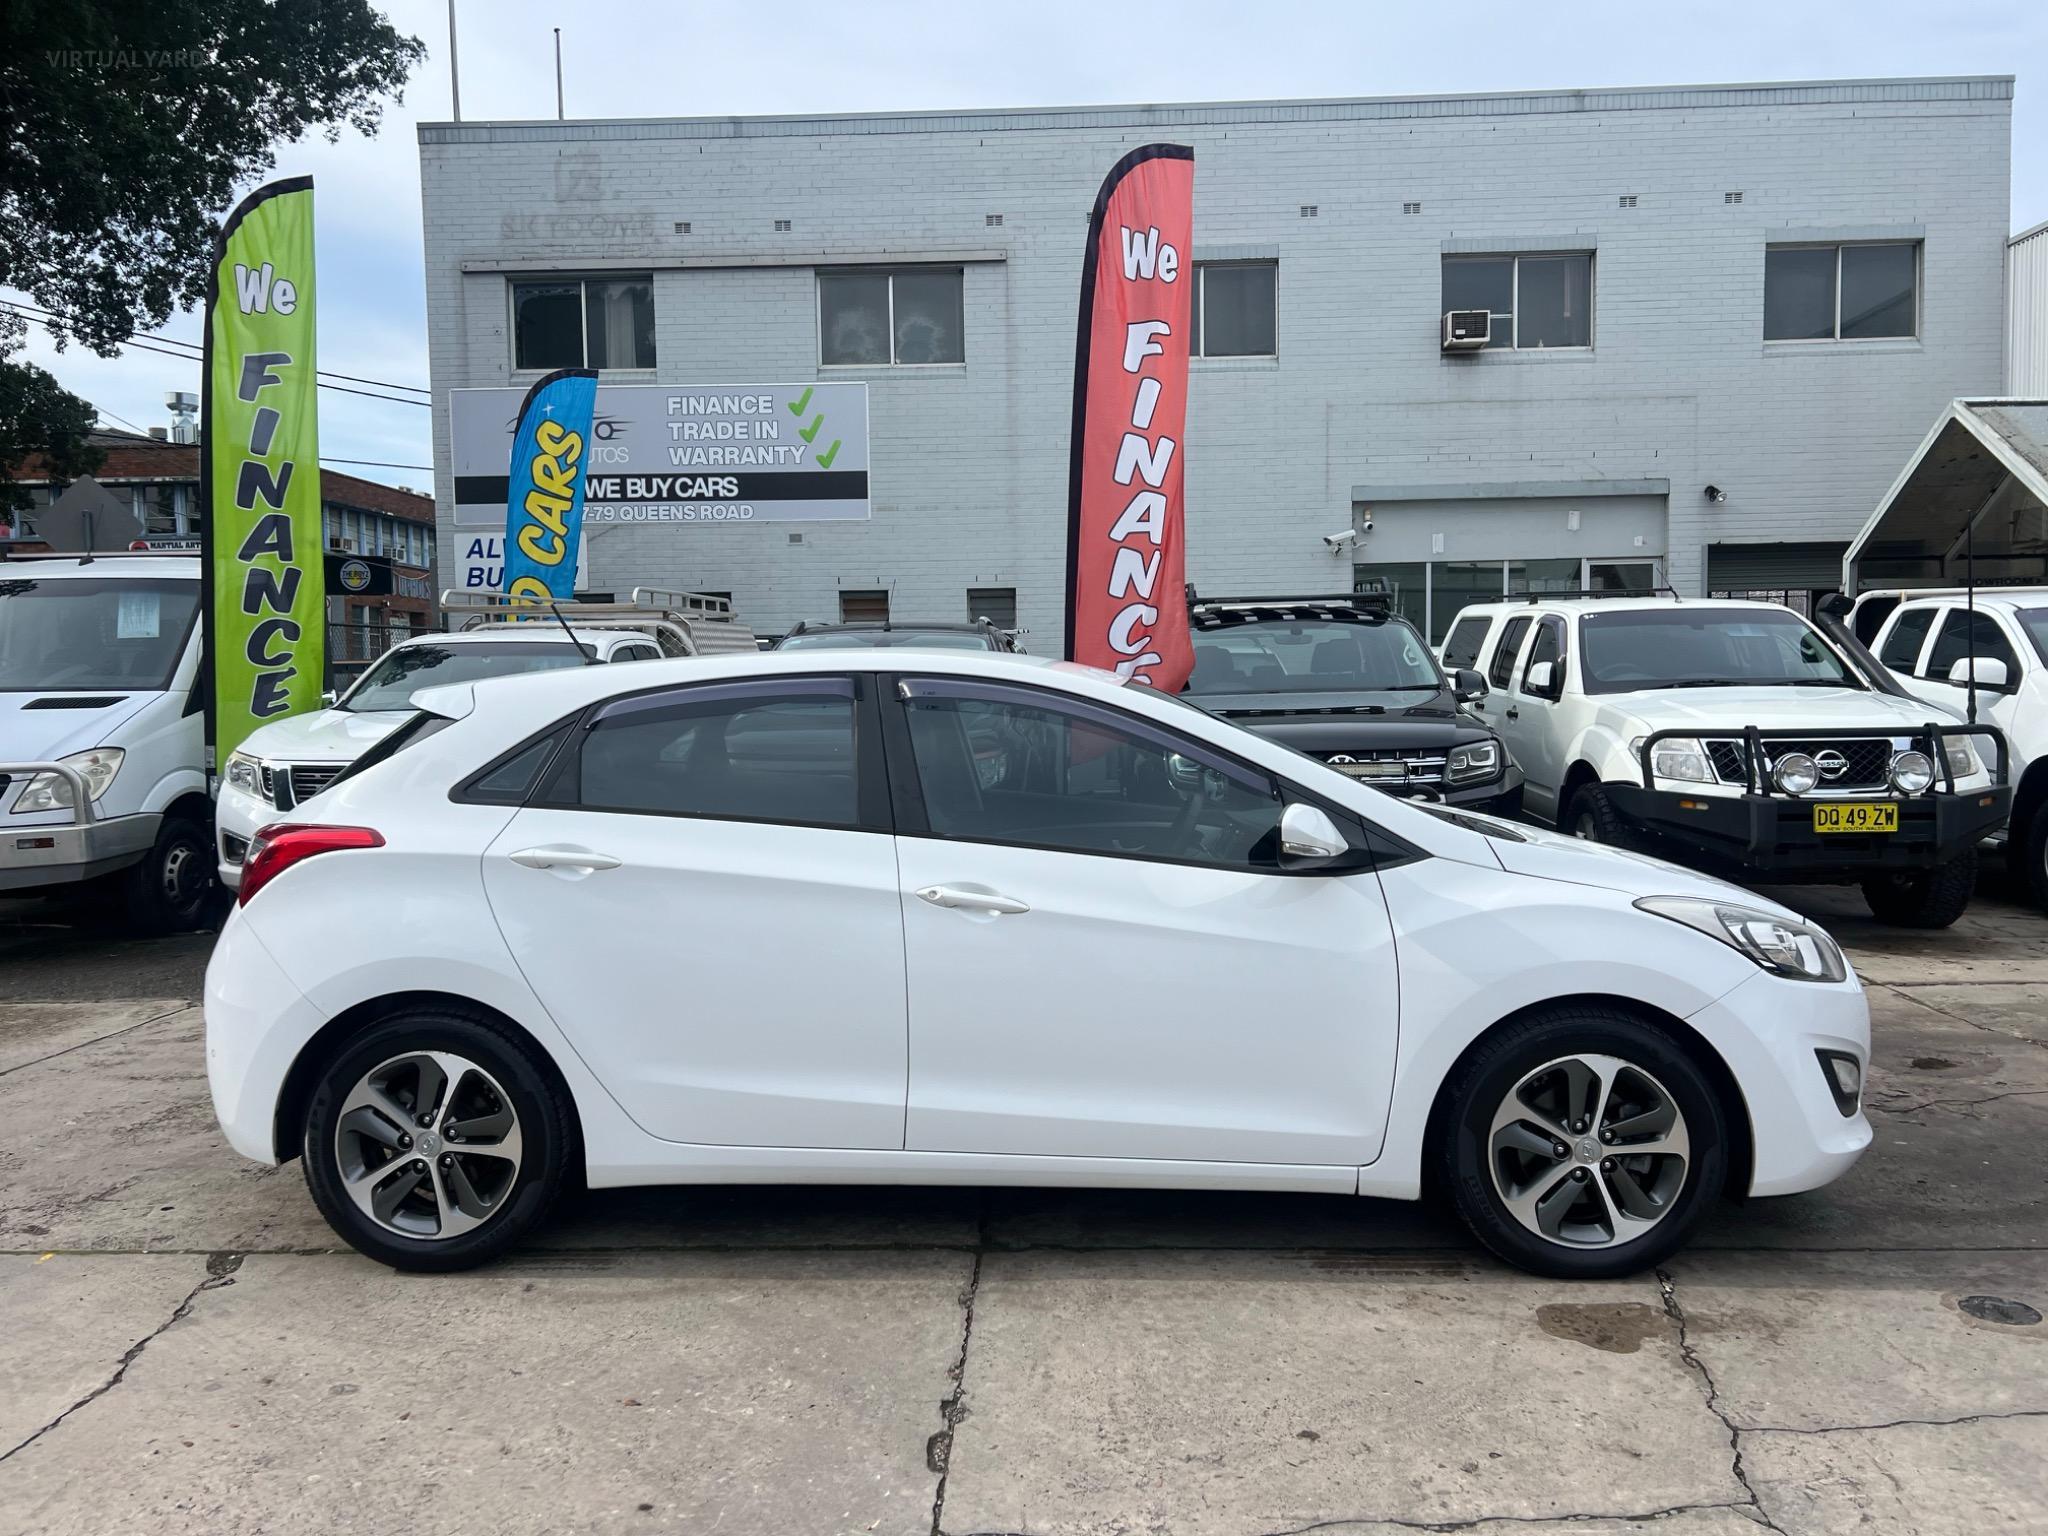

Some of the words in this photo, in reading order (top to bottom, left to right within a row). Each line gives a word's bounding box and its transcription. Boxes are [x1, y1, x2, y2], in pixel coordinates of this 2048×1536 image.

[1120, 225, 1179, 283] We
[234, 262, 297, 315] We
[666, 395, 774, 416] FINANCE
[667, 421, 749, 441] TRADE
[754, 420, 779, 440] IN
[668, 445, 807, 466] WARRANTY
[517, 420, 584, 566] CARS
[585, 477, 621, 499] WE
[626, 476, 674, 499] BUY
[675, 476, 739, 498] CARS
[619, 504, 696, 521] QUEENS
[700, 504, 754, 520] ROAD
[150, 541, 183, 549] MARTIAL
[236, 352, 302, 718] FINANCE
